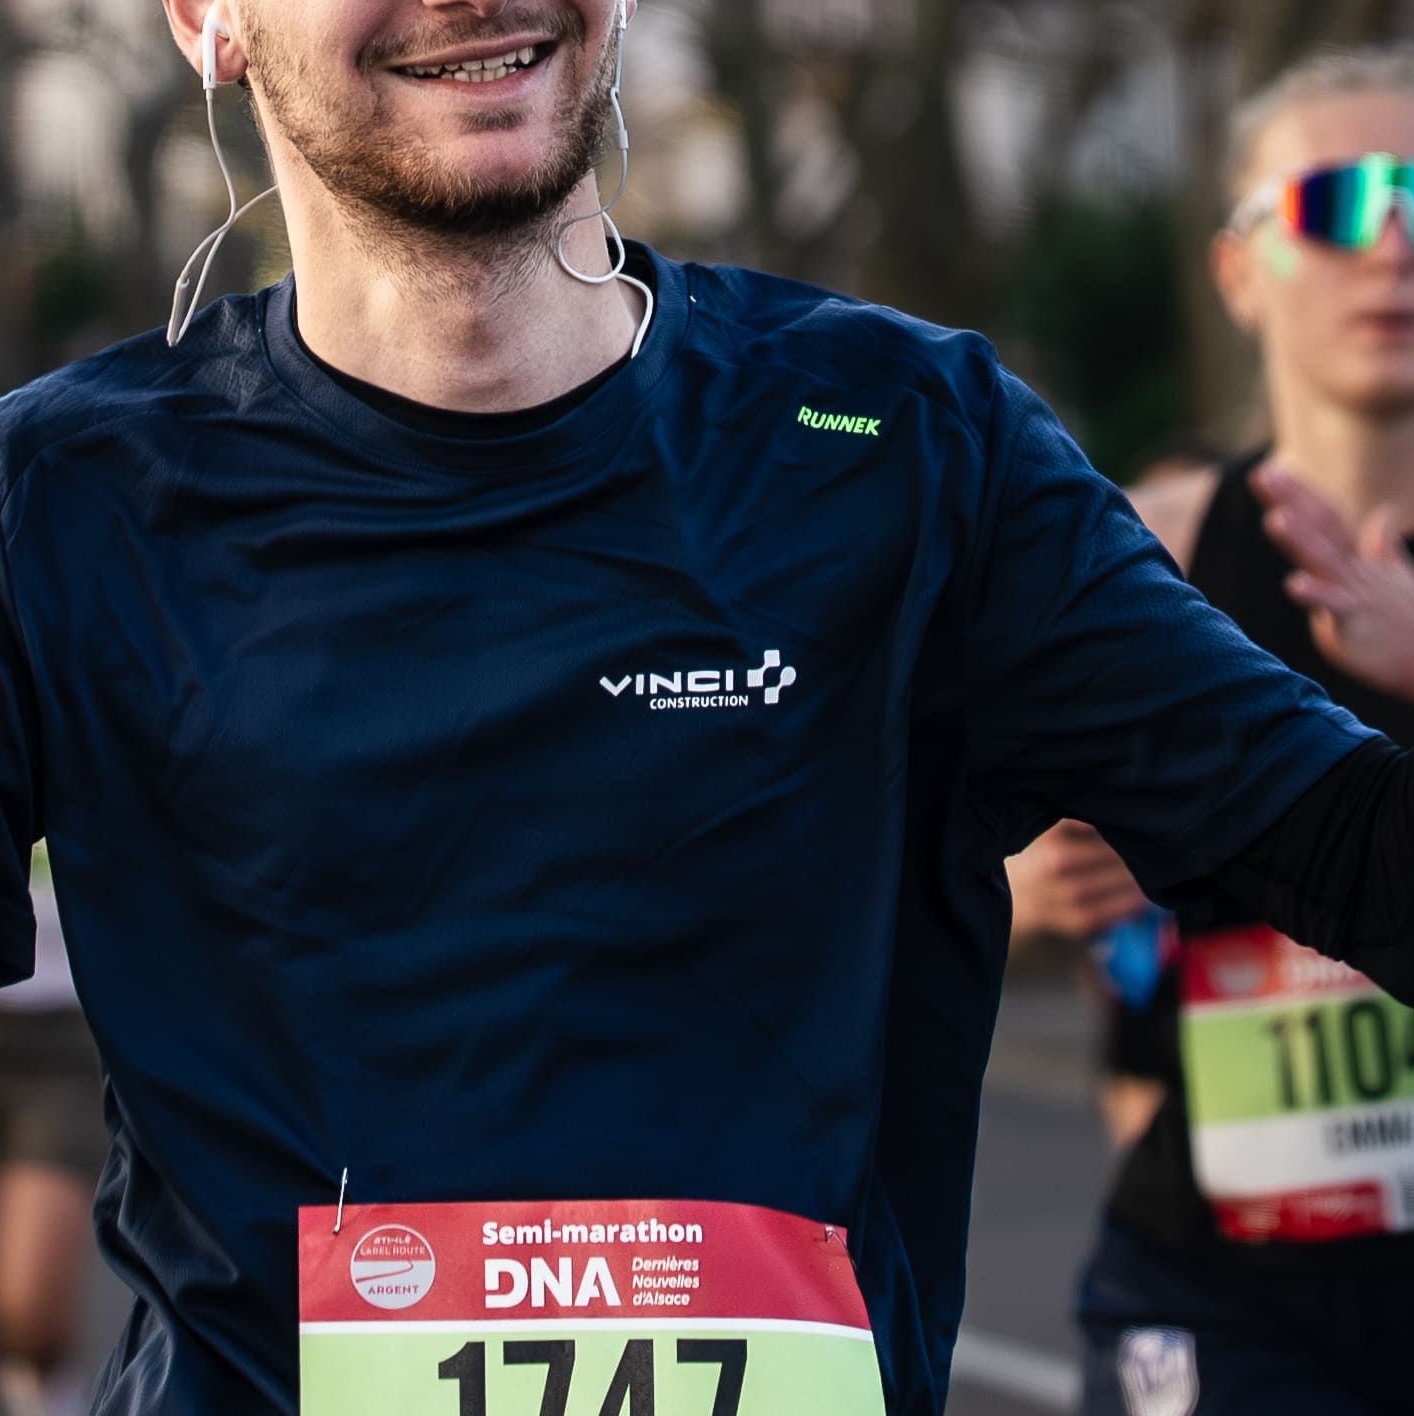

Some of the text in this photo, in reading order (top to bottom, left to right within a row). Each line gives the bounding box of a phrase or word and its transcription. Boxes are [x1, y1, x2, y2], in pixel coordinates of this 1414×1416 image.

[797, 406, 882, 436] RUNNEK
[599, 669, 734, 696] VINCI
[650, 695, 749, 710] CONSTRUCTION
[482, 1218, 703, 1245] Semi-marathon
[631, 1255, 700, 1272] Dernières
[484, 1256, 622, 1309] DNA
[631, 1273, 700, 1289] Nouvelles
[368, 1285, 420, 1295] ARGENT
[632, 1291, 691, 1306] d'Alsace
